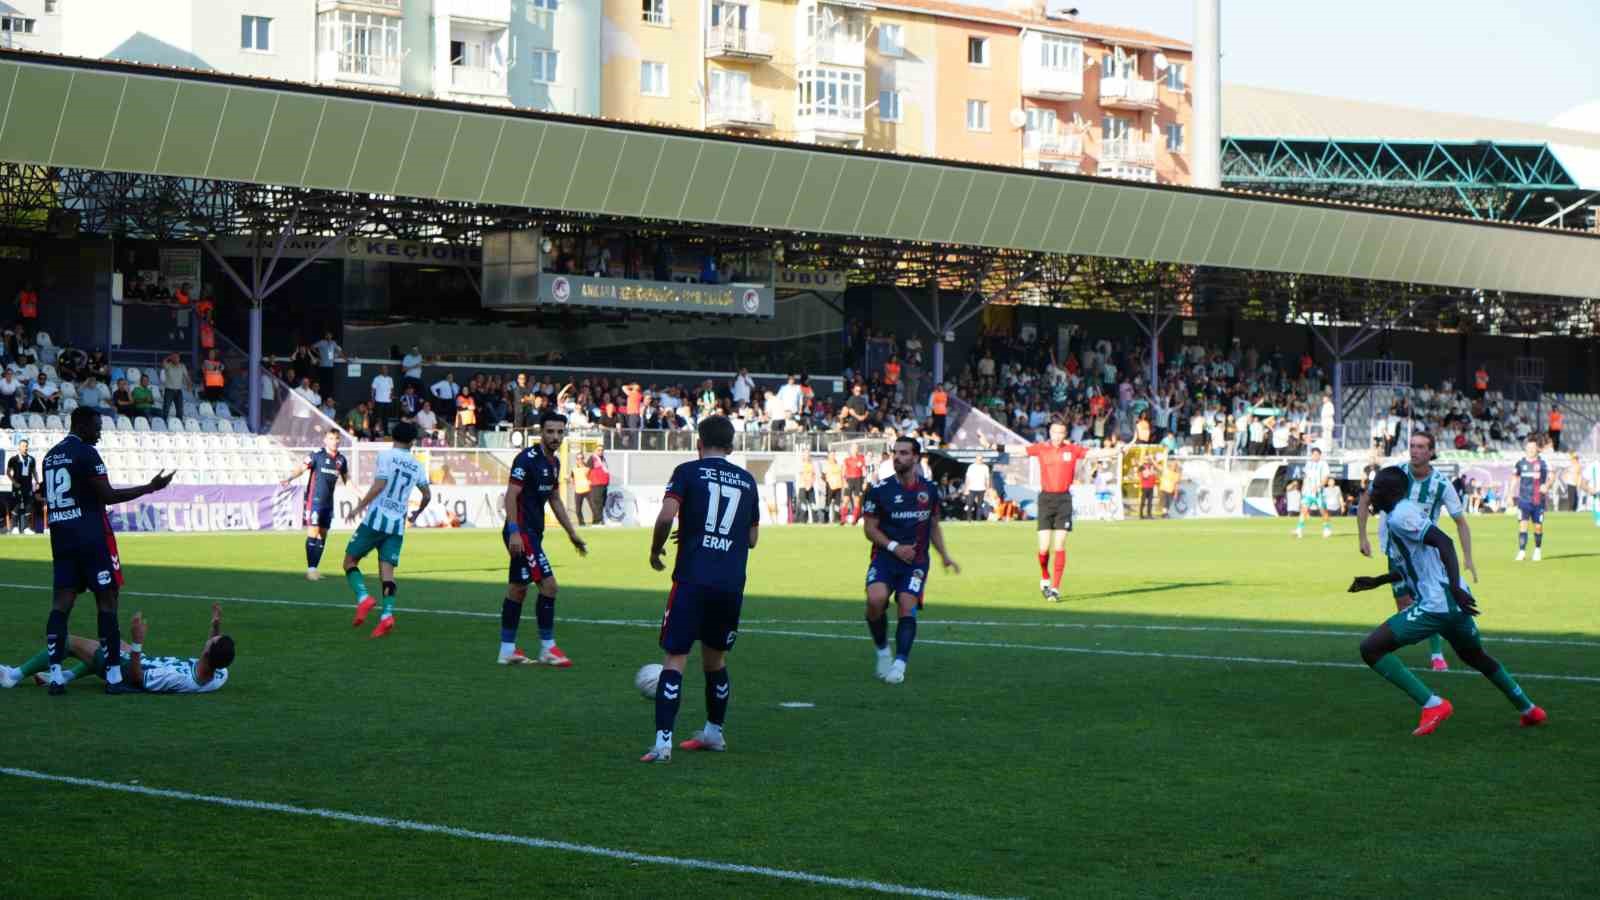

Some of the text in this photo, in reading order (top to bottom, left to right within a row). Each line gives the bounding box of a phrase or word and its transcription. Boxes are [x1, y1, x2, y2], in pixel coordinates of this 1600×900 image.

[386, 468, 412, 502] 17
[704, 481, 742, 535] 17
[702, 534, 733, 552] ERAY
